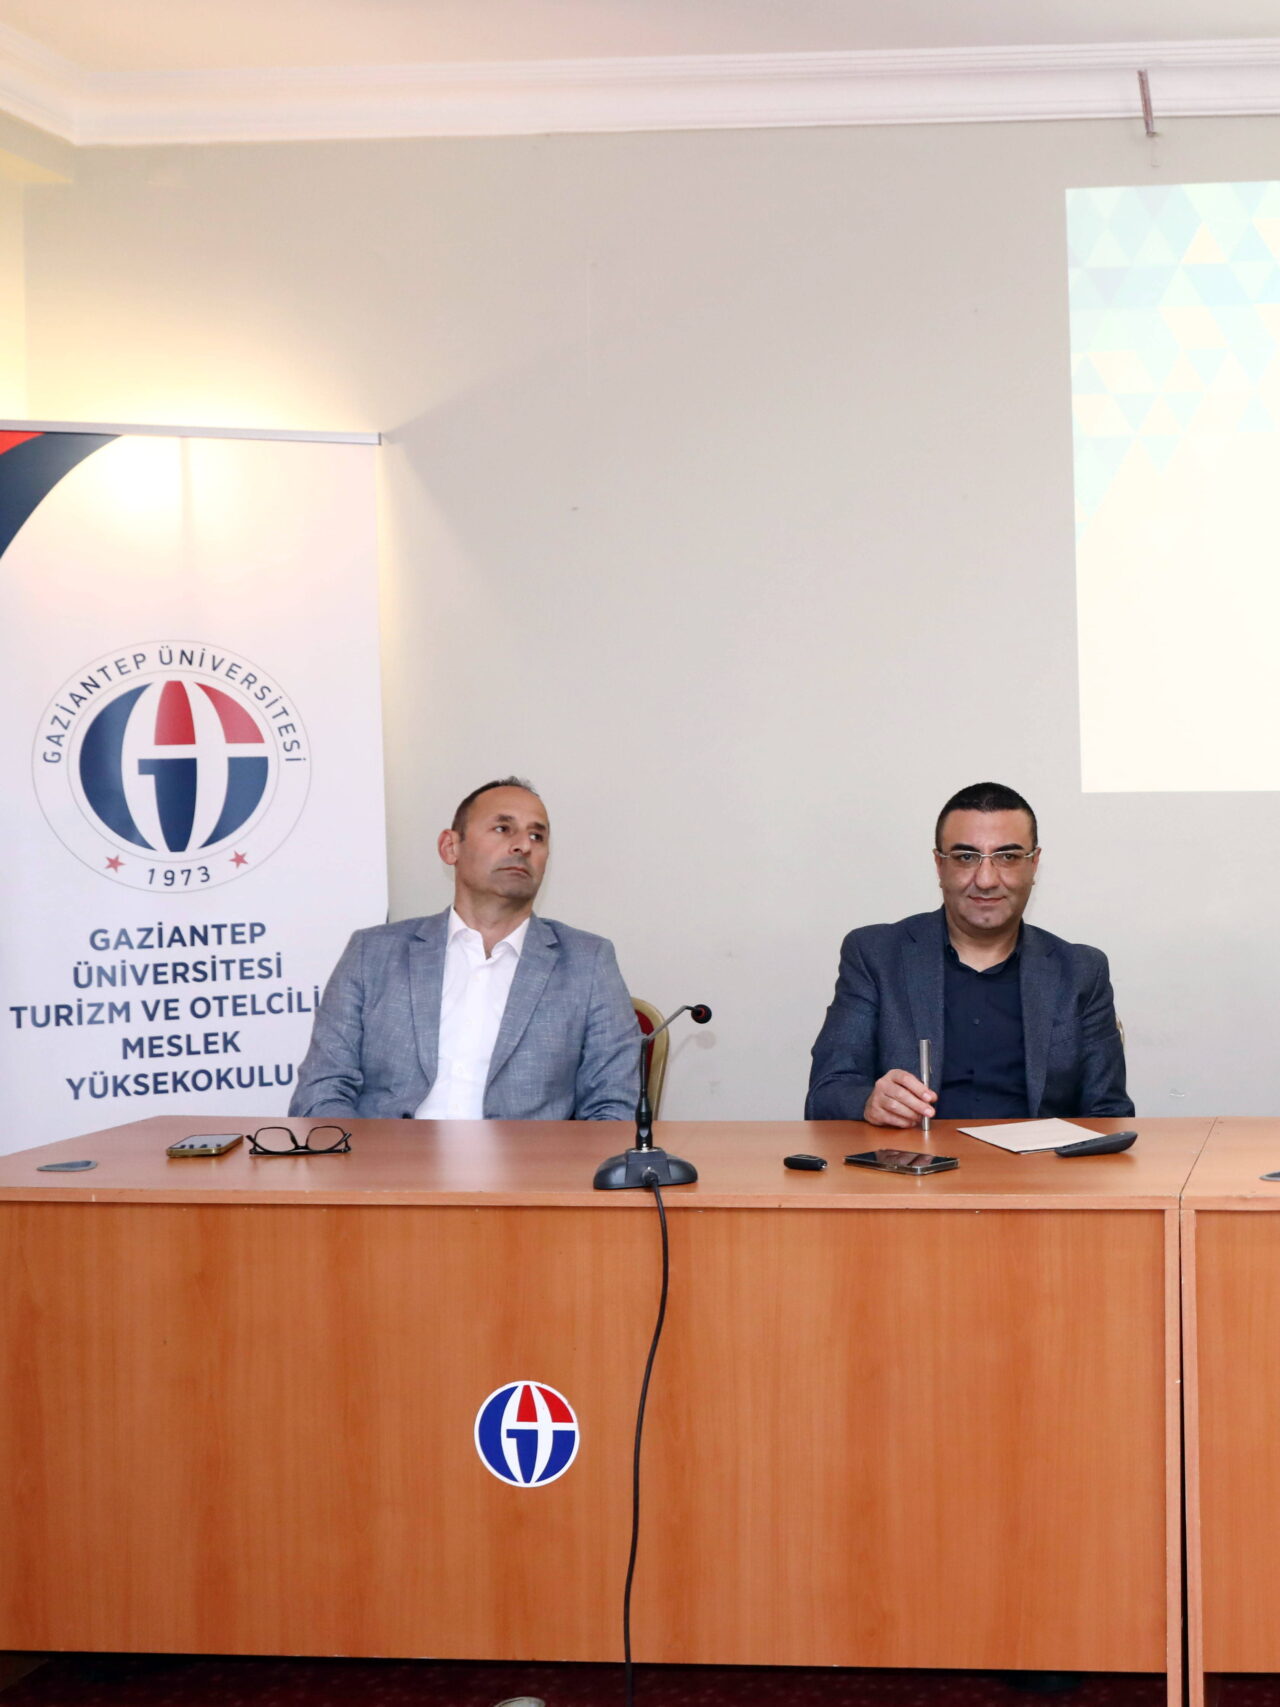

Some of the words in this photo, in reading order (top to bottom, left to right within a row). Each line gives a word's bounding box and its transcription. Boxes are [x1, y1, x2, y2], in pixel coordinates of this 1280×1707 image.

[42, 652, 147, 764] GAZİANTEP
[158, 645, 307, 763] ÜNİVERSİTESİ
[148, 865, 211, 887] 1973
[89, 921, 266, 951] GAZİANTEP
[72, 952, 283, 989] ÜNİVERSİTESİ
[10, 998, 131, 1029] TURİZM
[142, 998, 180, 1021] VE
[190, 985, 320, 1018] OTELCİLİ
[121, 1030, 241, 1060] MESLEK
[66, 1063, 294, 1101] YÜKSEKOKULU
